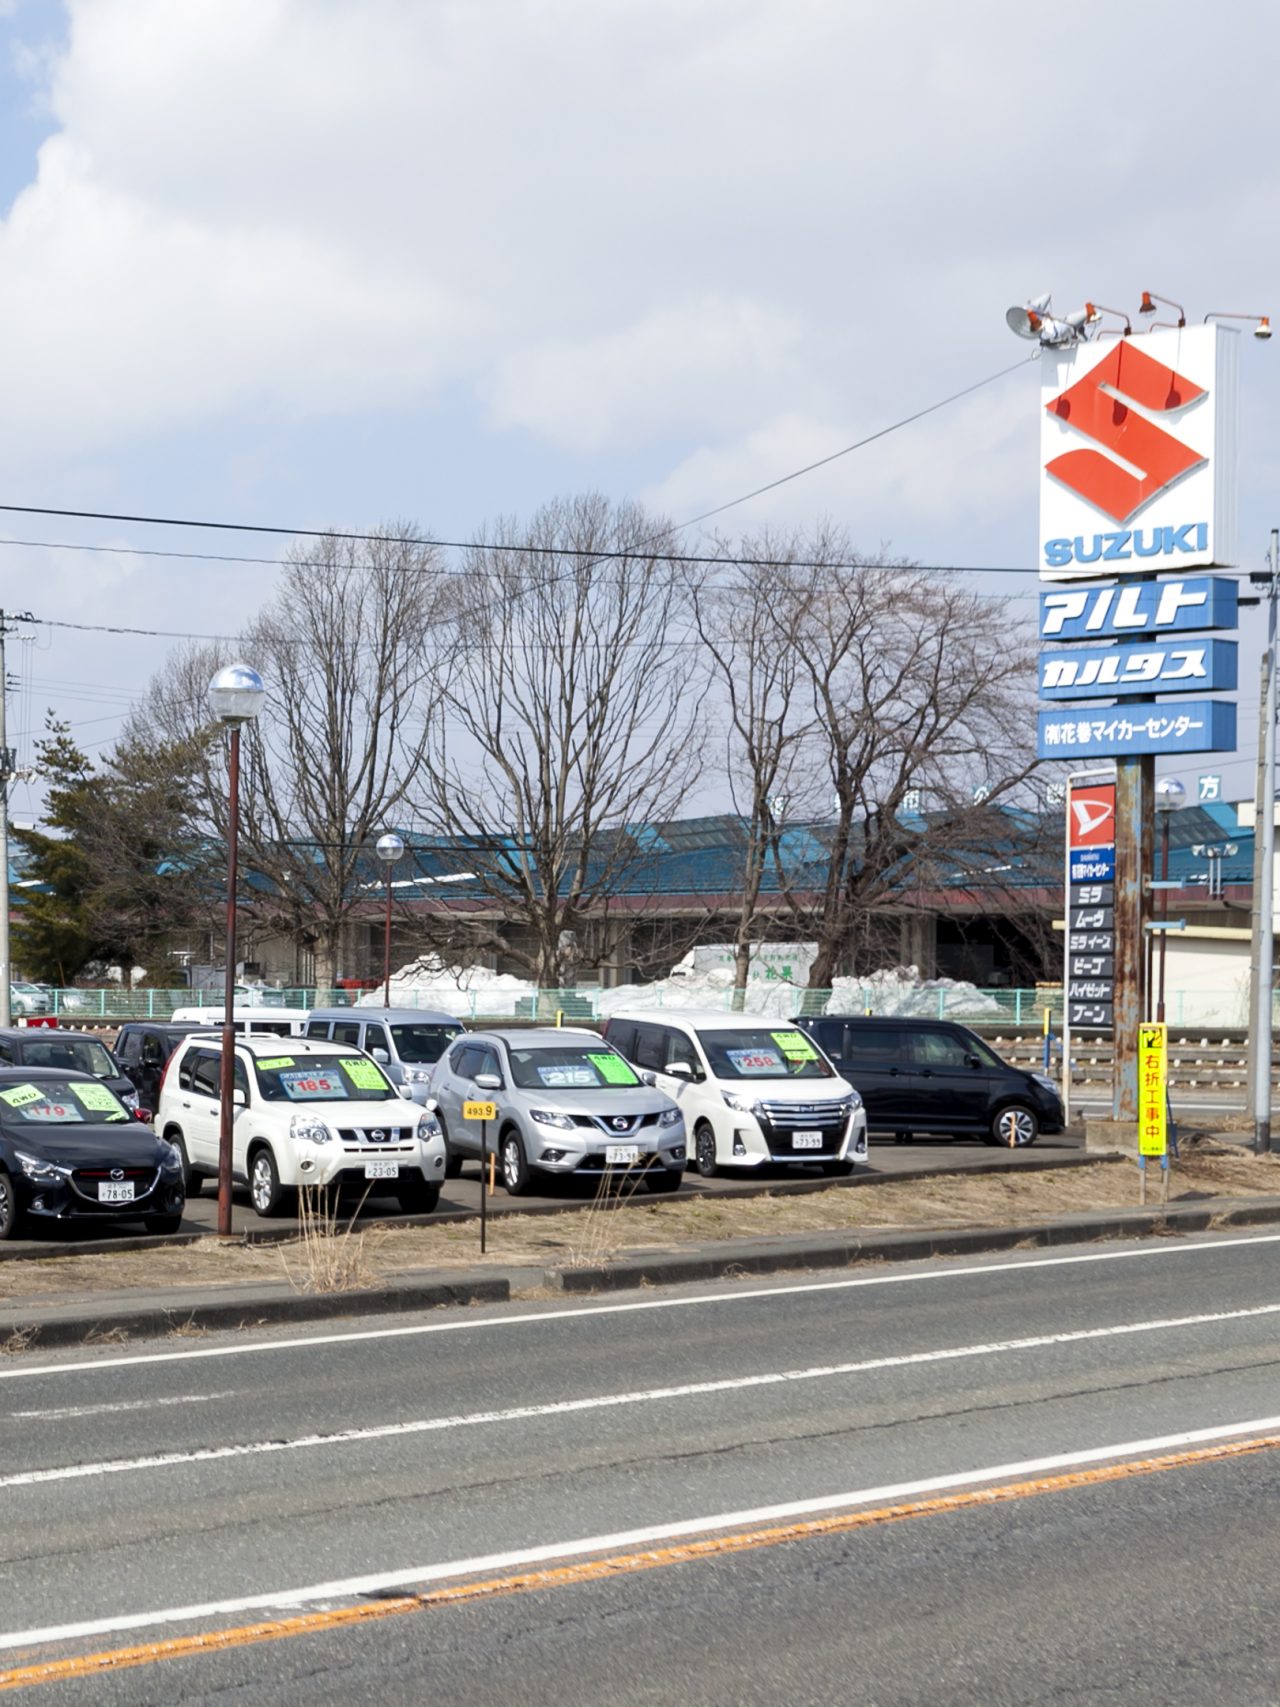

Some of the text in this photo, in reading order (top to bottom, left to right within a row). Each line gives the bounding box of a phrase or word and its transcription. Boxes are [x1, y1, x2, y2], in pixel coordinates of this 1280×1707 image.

[1044, 522, 1208, 567] SUZUKI
[1042, 583, 1207, 634] アルト
[1042, 649, 1207, 688] カルタス
[1199, 777, 1219, 799] 方
[1078, 887, 1102, 903] ミラ
[1075, 911, 1104, 928] ムーヴ
[1069, 983, 1110, 998] ハイゼット
[1145, 1055, 1159, 1138] 右折工事中
[107, 1189, 133, 1199] 78-05
